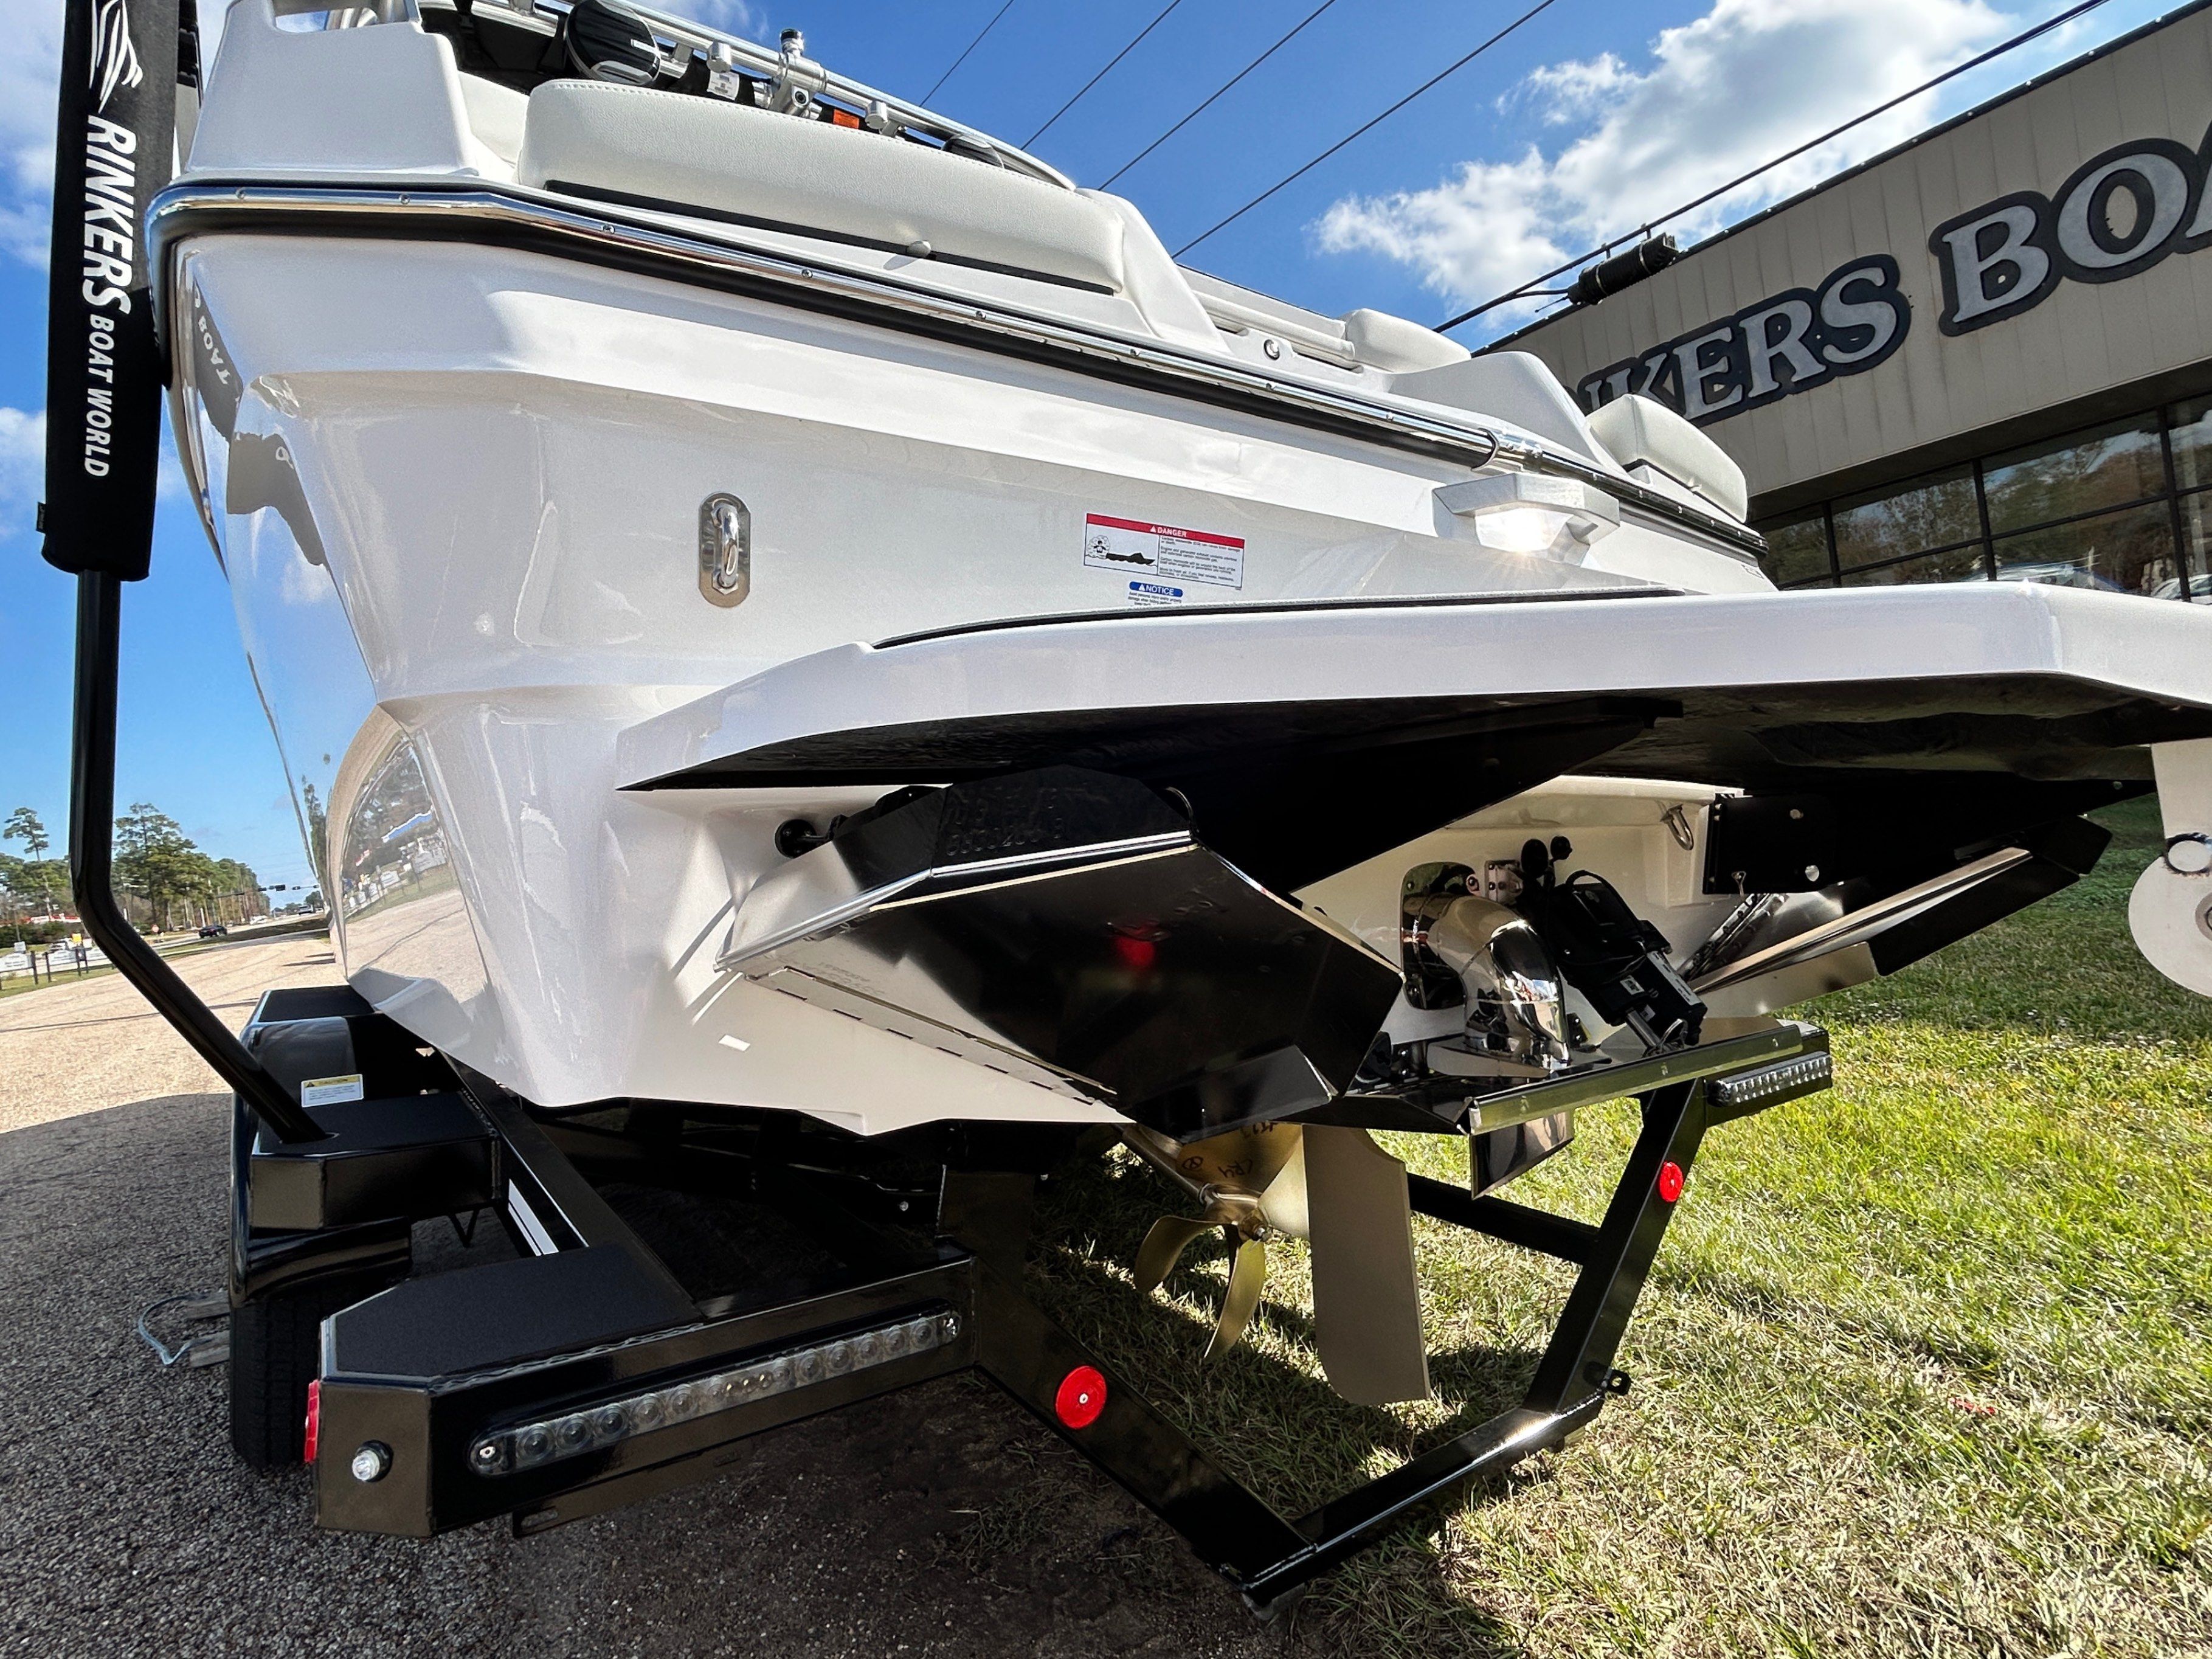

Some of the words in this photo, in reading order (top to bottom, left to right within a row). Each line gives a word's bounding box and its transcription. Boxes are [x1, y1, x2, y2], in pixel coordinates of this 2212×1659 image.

[82, 114, 136, 314] RINKERS
[1585, 266, 1897, 420] KERS
[1941, 153, 2212, 323] BO
[88, 313, 114, 384] BOAT
[84, 388, 112, 477] WORLD
[1157, 527, 1187, 538] DANGER
[1146, 584, 1174, 595] NOTICE
